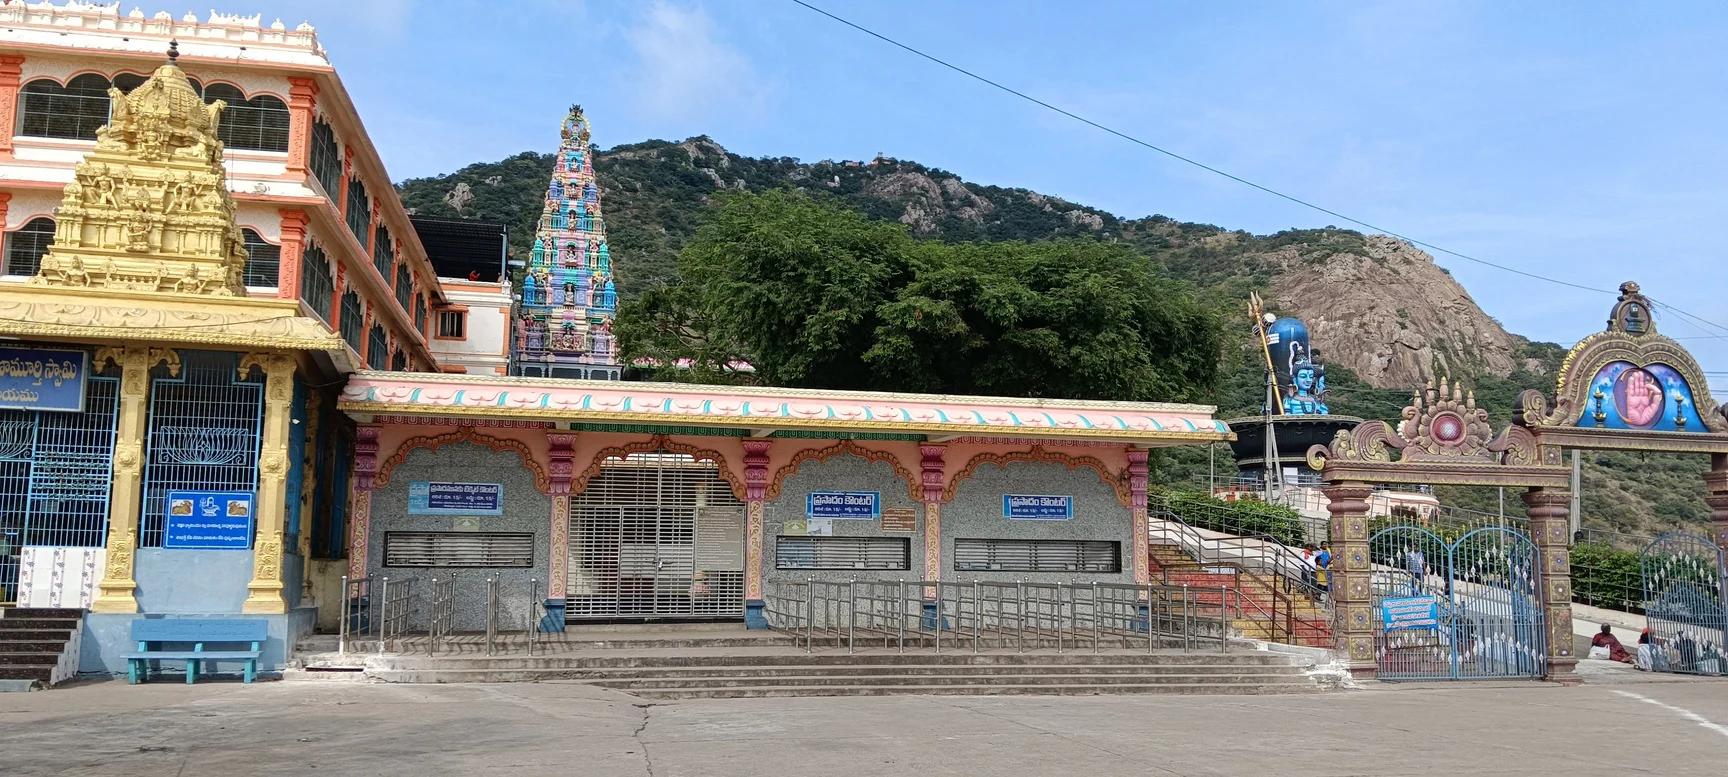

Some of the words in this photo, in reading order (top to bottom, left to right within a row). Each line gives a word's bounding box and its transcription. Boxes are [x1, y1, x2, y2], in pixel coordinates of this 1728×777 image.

[45, 358, 77, 387] స్వామి
[0, 388, 39, 402] యము
[814, 495, 843, 505] ప్రసాదం
[844, 495, 872, 505] కౌంటర్
[1012, 497, 1039, 507] ప్రసాదం
[1040, 497, 1066, 506] కౌంటర్
